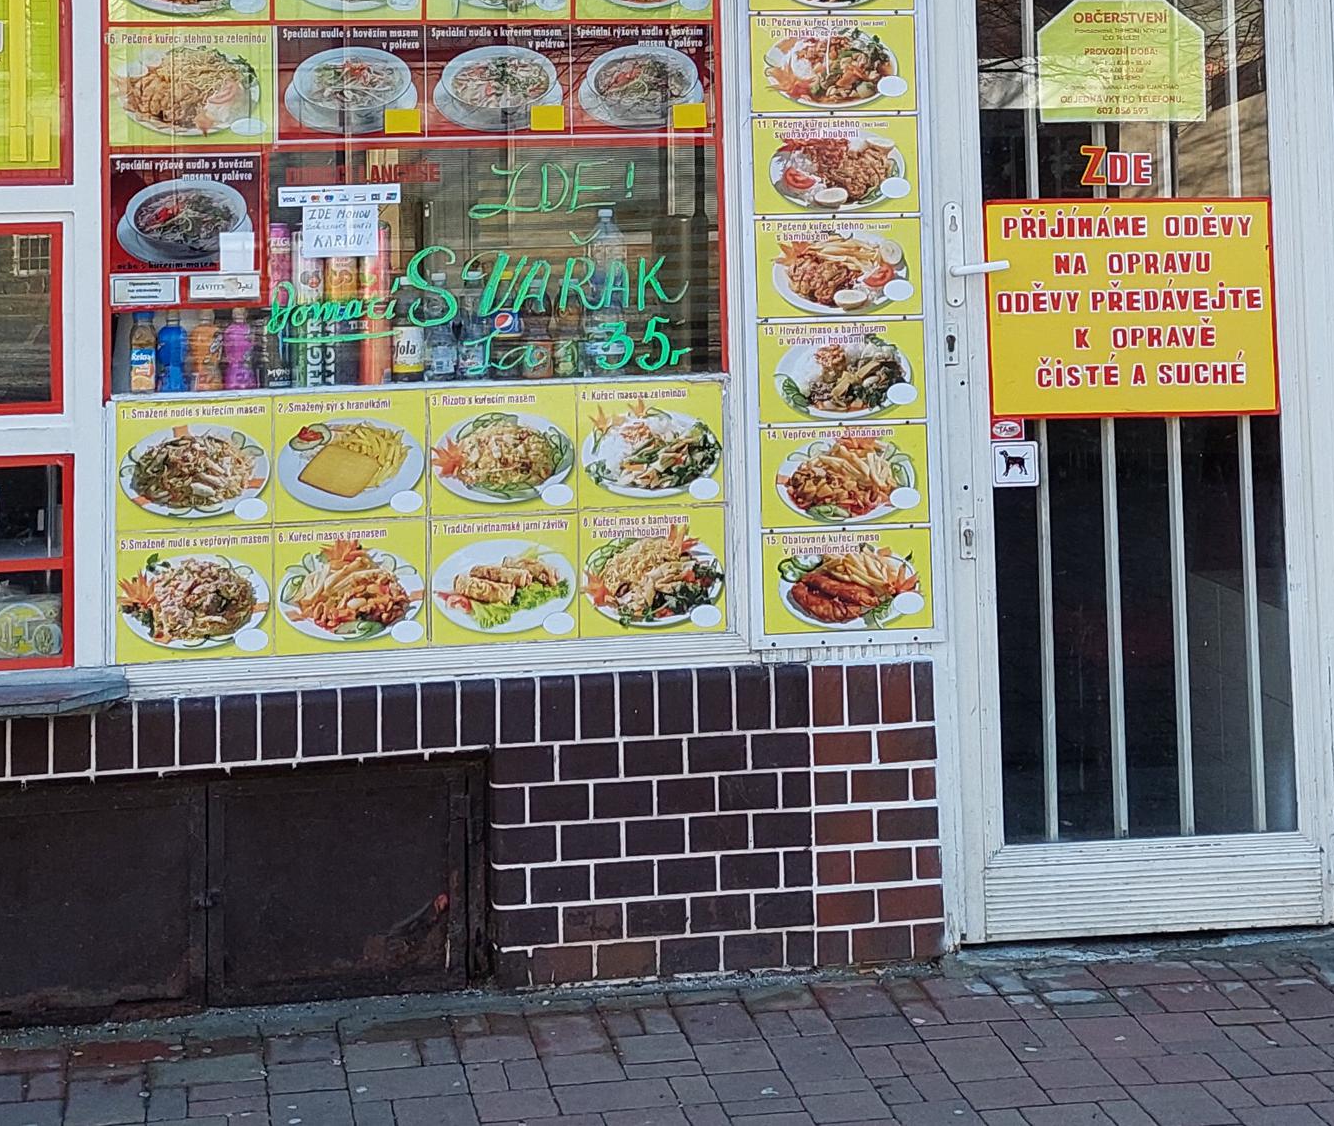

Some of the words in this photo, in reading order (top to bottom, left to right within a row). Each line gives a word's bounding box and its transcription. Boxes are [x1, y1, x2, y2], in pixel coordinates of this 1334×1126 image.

[772, 18, 802, 26] Pečené
[804, 18, 829, 26] kuřecí
[1073, 9, 1167, 24] OBČERSTVENÍ
[283, 28, 318, 39] Speciální
[320, 28, 344, 38] nudle
[431, 27, 467, 38] Speciální
[469, 27, 492, 37] nudle
[533, 29, 561, 37] masem
[640, 26, 663, 37] nudle
[771, 29, 781, 38] po
[121, 33, 153, 44] Pečené
[183, 33, 211, 44] stehno
[227, 34, 267, 43] zeleninou
[1084, 46, 1128, 56] PROVOZNÍ
[1097, 107, 1112, 115] 602
[758, 120, 770, 129] 11.
[773, 119, 802, 129] Pečené
[805, 119, 831, 128] kuřecí
[833, 119, 860, 128] stehno
[823, 129, 859, 138] houbami
[185, 160, 209, 170] nudle
[1080, 145, 1152, 186] ZDE
[307, 209, 332, 220] ZDE
[762, 223, 774, 231] 12.
[777, 222, 806, 231] Pečené
[809, 222, 834, 231] kuřecí
[837, 222, 864, 230] stehno
[1164, 206, 1253, 237] ODĚVY
[1054, 253, 1087, 275] NA
[1108, 251, 1211, 274] OPRAVU
[997, 282, 1081, 314] ODĚVY
[1090, 279, 1263, 312] PŘEDÁVEJTE
[764, 327, 777, 335] 13.
[779, 325, 807, 335] Hovězí
[841, 325, 886, 333] bambusem
[1075, 328, 1091, 350] K
[1112, 317, 1216, 349] OPRAVĚ
[786, 336, 826, 345] voňavými
[1037, 353, 1119, 388] ČISTÉ
[1132, 364, 1147, 385] A
[1159, 351, 1246, 385] SUCHÉ
[432, 396, 440, 406] 3.
[442, 396, 466, 406] Rizoto
[507, 395, 535, 403] masem
[582, 391, 589, 400] 4.
[591, 390, 615, 400] Kuřecí
[121, 408, 129, 420] 1.
[131, 407, 167, 420] Smažené
[201, 404, 234, 416] kuřecím
[237, 405, 265, 414] masem
[289, 400, 325, 414] Smažený
[767, 430, 780, 439] 14.
[783, 429, 816, 439] Vepřové
[818, 430, 841, 438] maso
[593, 515, 617, 526] Kuřecí
[619, 516, 639, 525] maso
[648, 514, 689, 524] bambusem
[433, 525, 441, 534] 7.
[443, 524, 475, 534] Tradiční
[476, 521, 520, 532] vietnamské
[599, 526, 635, 538] voňavými
[121, 540, 129, 550] 5.
[129, 538, 165, 550] Smažené
[168, 536, 191, 547] nudle
[199, 534, 239, 546] vepřovým
[241, 535, 269, 544] masem
[278, 534, 287, 543] 6.
[289, 531, 314, 542] Kuřecí
[766, 536, 779, 545] 15.
[782, 534, 826, 544] Obalované
[828, 533, 854, 543] kuřecí
[856, 534, 879, 542] maso
